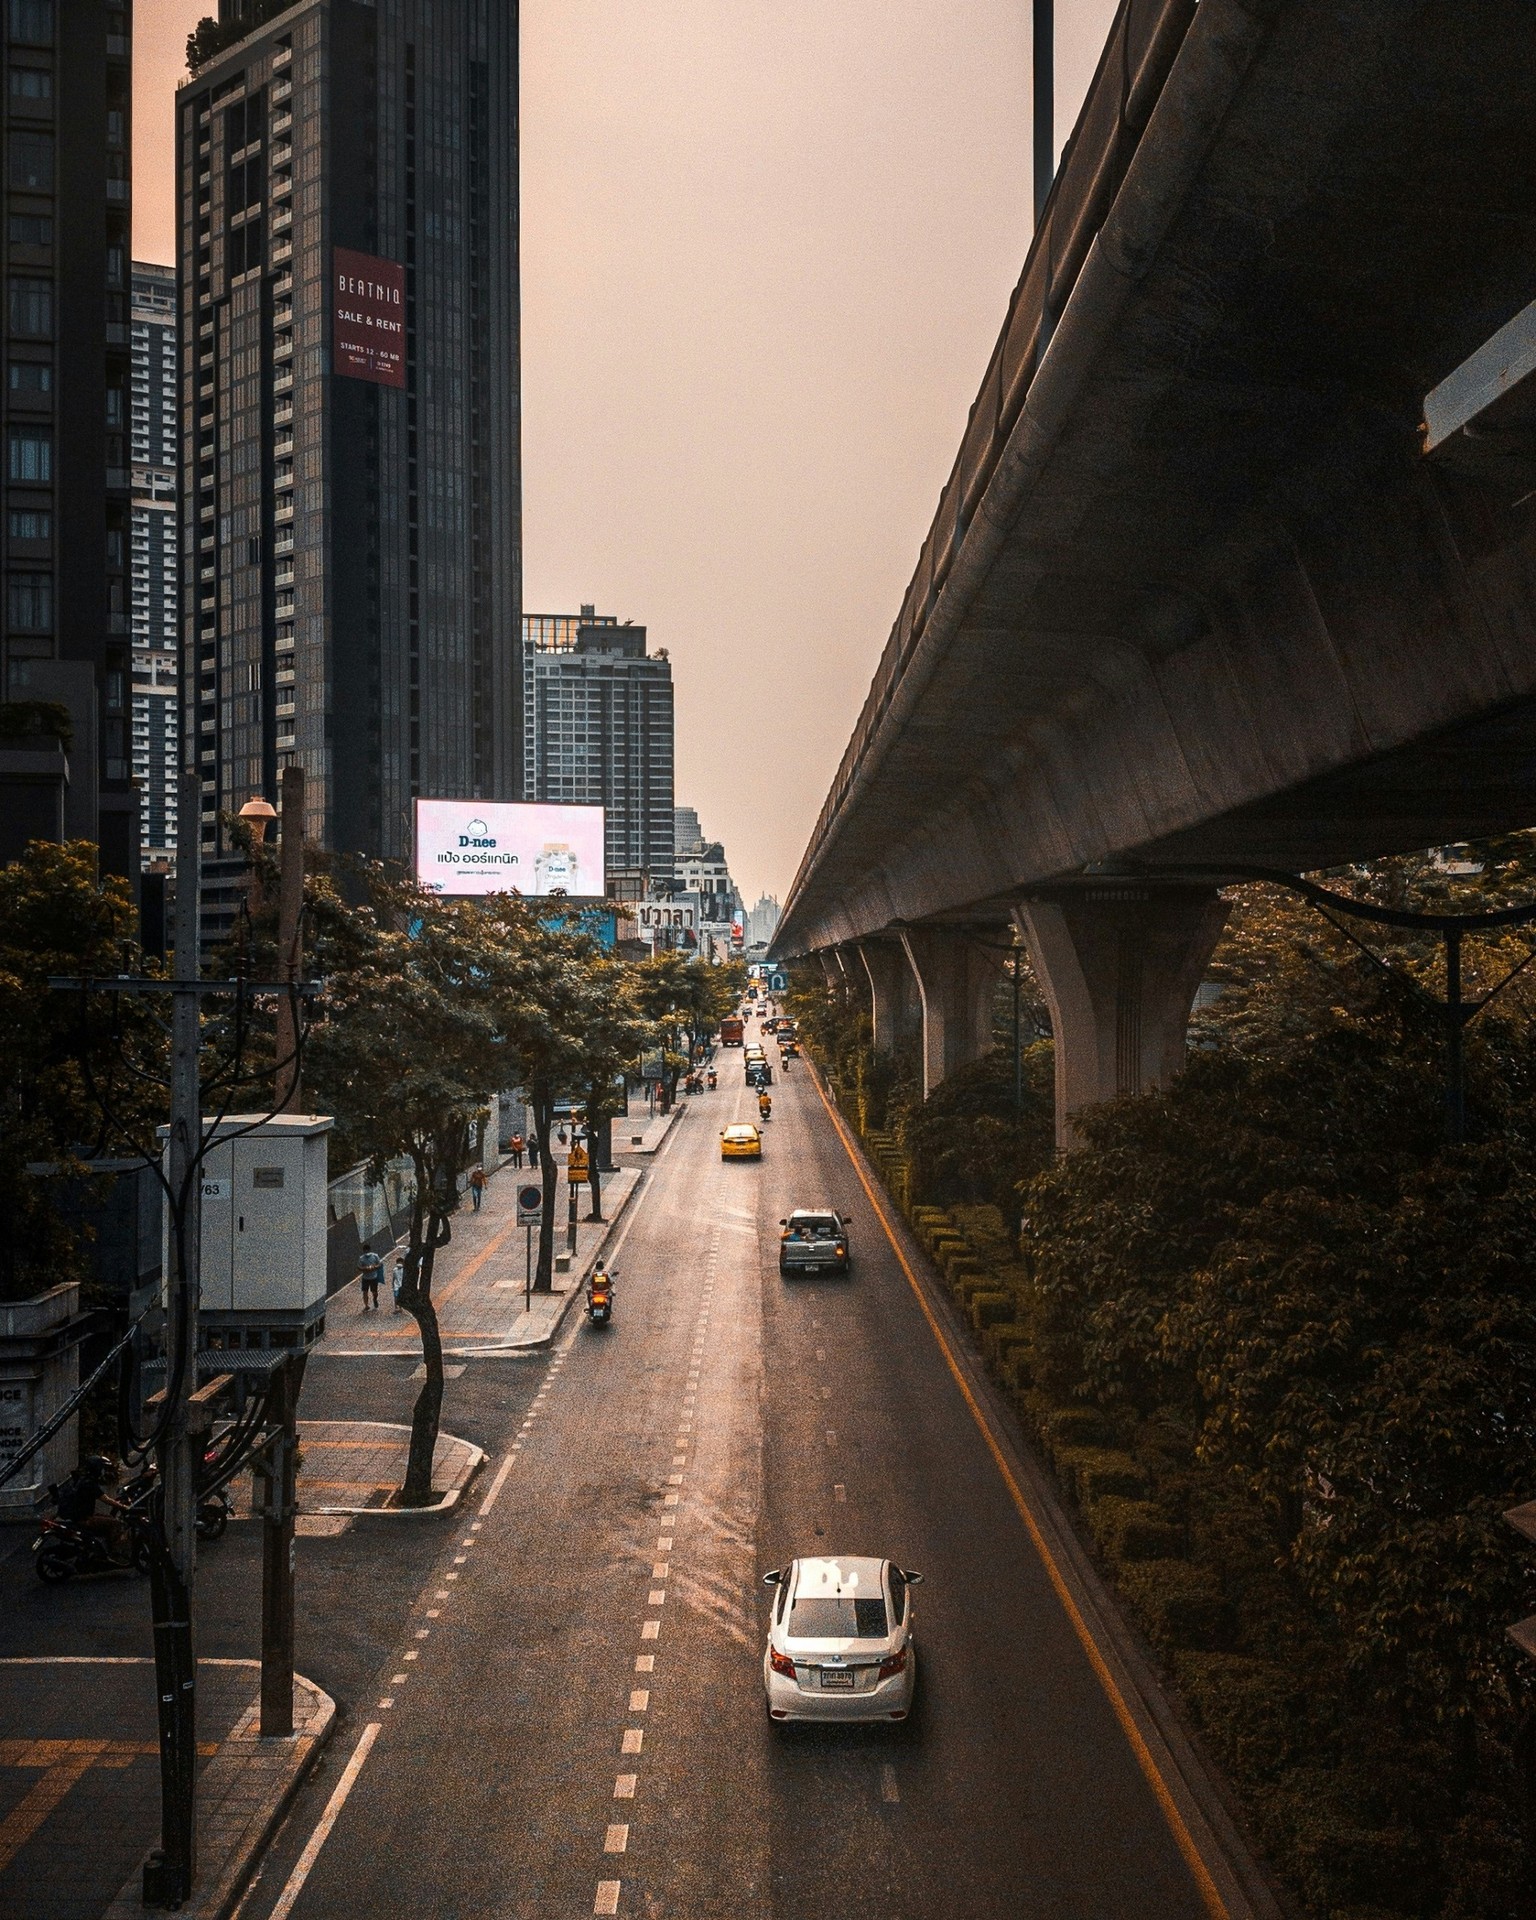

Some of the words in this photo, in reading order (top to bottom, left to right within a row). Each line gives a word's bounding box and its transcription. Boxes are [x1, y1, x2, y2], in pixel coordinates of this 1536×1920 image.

[339, 275, 400, 304] BEATNIQ
[338, 309, 363, 323] SALE
[366, 316, 373, 326] &
[376, 318, 402, 333] RENT
[340, 342, 364, 353] STARTS
[366, 347, 374, 356] 12
[459, 835, 497, 848] D-nee
[437, 851, 460, 863] แป้ง
[462, 852, 519, 864] ออร์แกนิค
